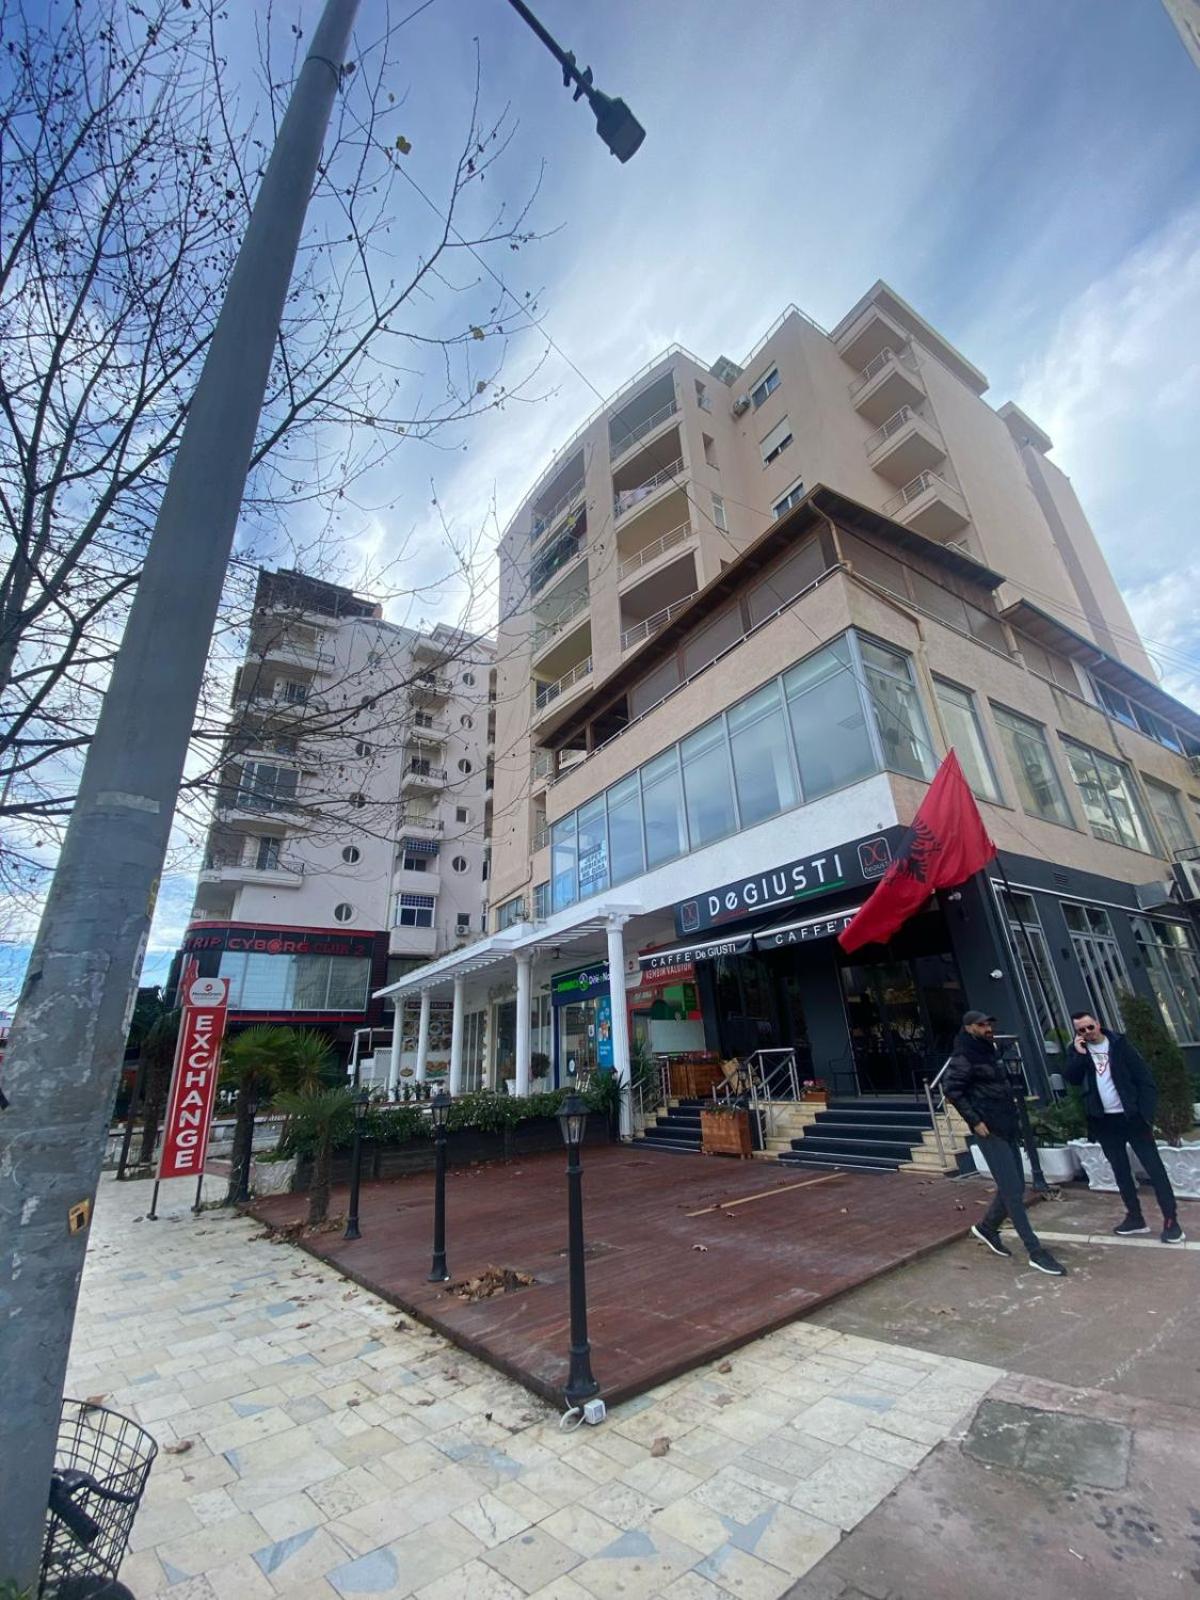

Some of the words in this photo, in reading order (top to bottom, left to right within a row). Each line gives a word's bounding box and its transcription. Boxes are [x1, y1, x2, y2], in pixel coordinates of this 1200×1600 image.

[775, 921, 837, 944] CAFFE'
[843, 917, 852, 929] D
[229, 938, 309, 954] CYBORG
[651, 952, 692, 967] CAFFE'
[695, 951, 706, 960] De
[707, 943, 736, 957] GIUSTI
[175, 1015, 214, 1169] EXCHANGE
